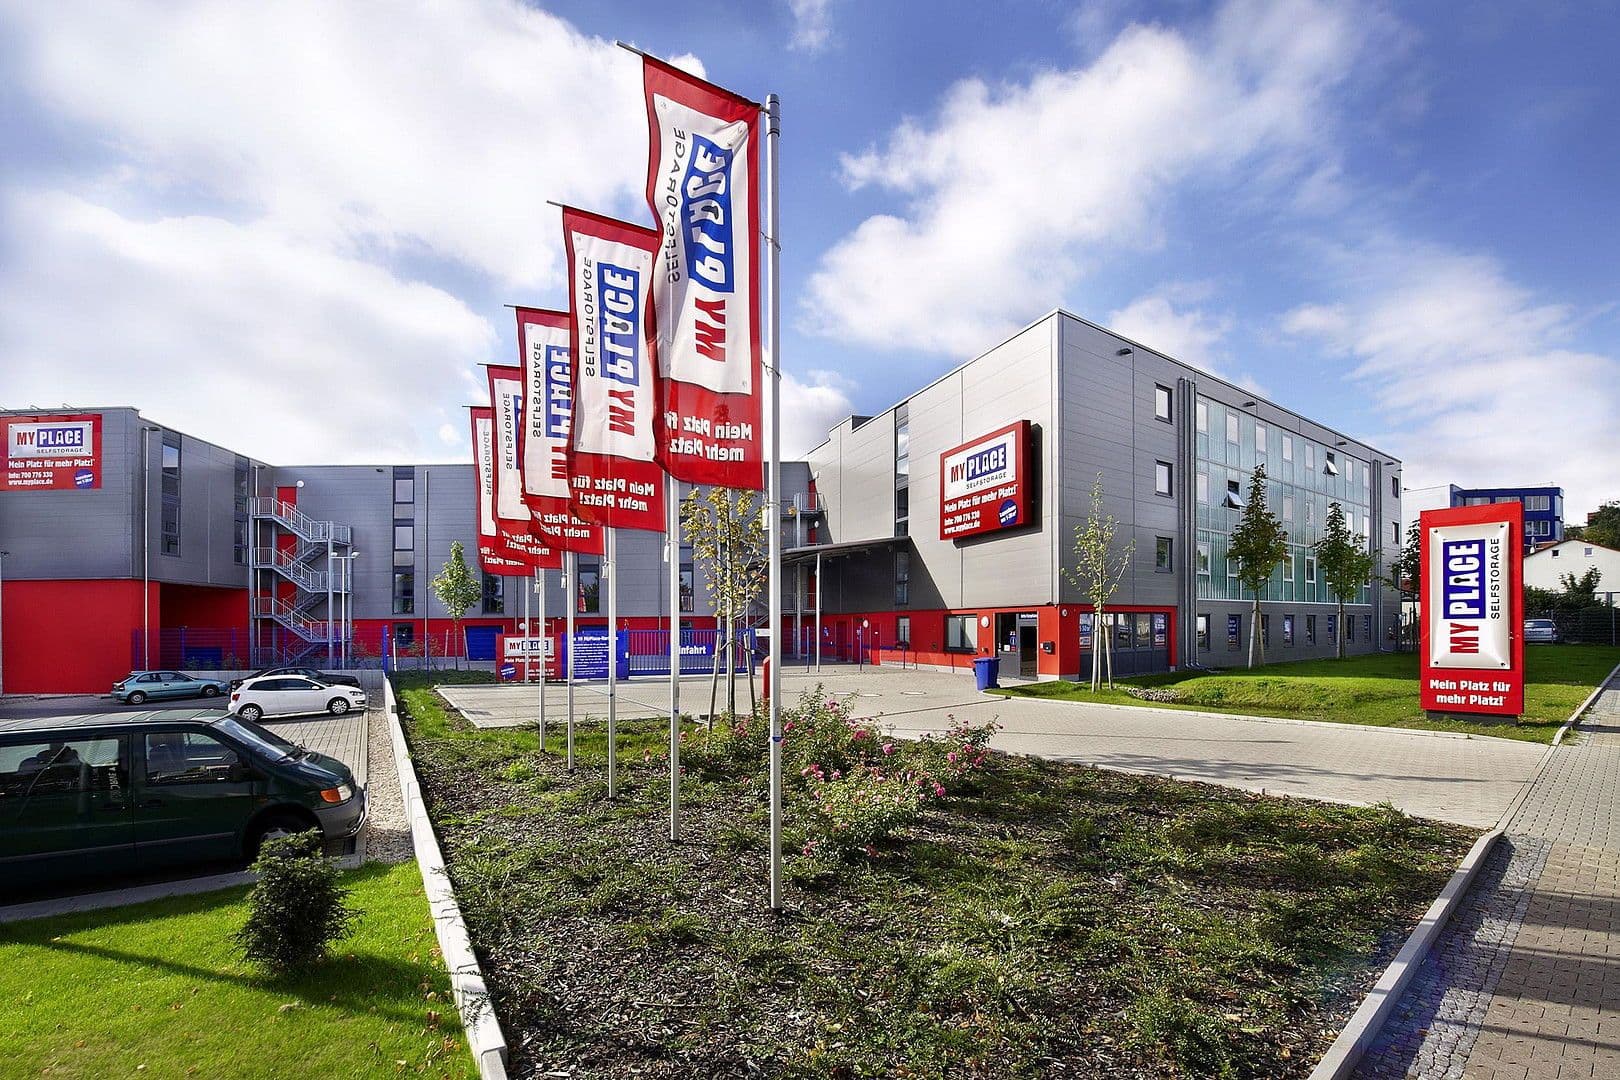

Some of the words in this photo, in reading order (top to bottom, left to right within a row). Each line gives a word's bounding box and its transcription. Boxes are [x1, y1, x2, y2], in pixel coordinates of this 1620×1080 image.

[16, 432, 35, 445] MY
[39, 430, 81, 445] PLACE
[8, 460, 24, 468] Mein
[26, 460, 42, 468] Platz
[44, 459, 54, 467] für
[55, 459, 72, 467] mehr
[951, 462, 965, 483] MY
[968, 447, 1006, 478] PLACE
[966, 472, 1007, 489] SELFSTORAGE
[1448, 543, 1480, 615] PLACE
[1491, 538, 1500, 619] SELFSTORAGE
[1450, 622, 1479, 653] MY
[510, 642, 520, 650] MY
[679, 645, 706, 655] infahrt
[1430, 679, 1456, 690] Mein
[1460, 680, 1489, 691] Platz
[1493, 681, 1511, 692] für
[1436, 694, 1466, 704] mehr
[1469, 694, 1503, 706] Platz!
